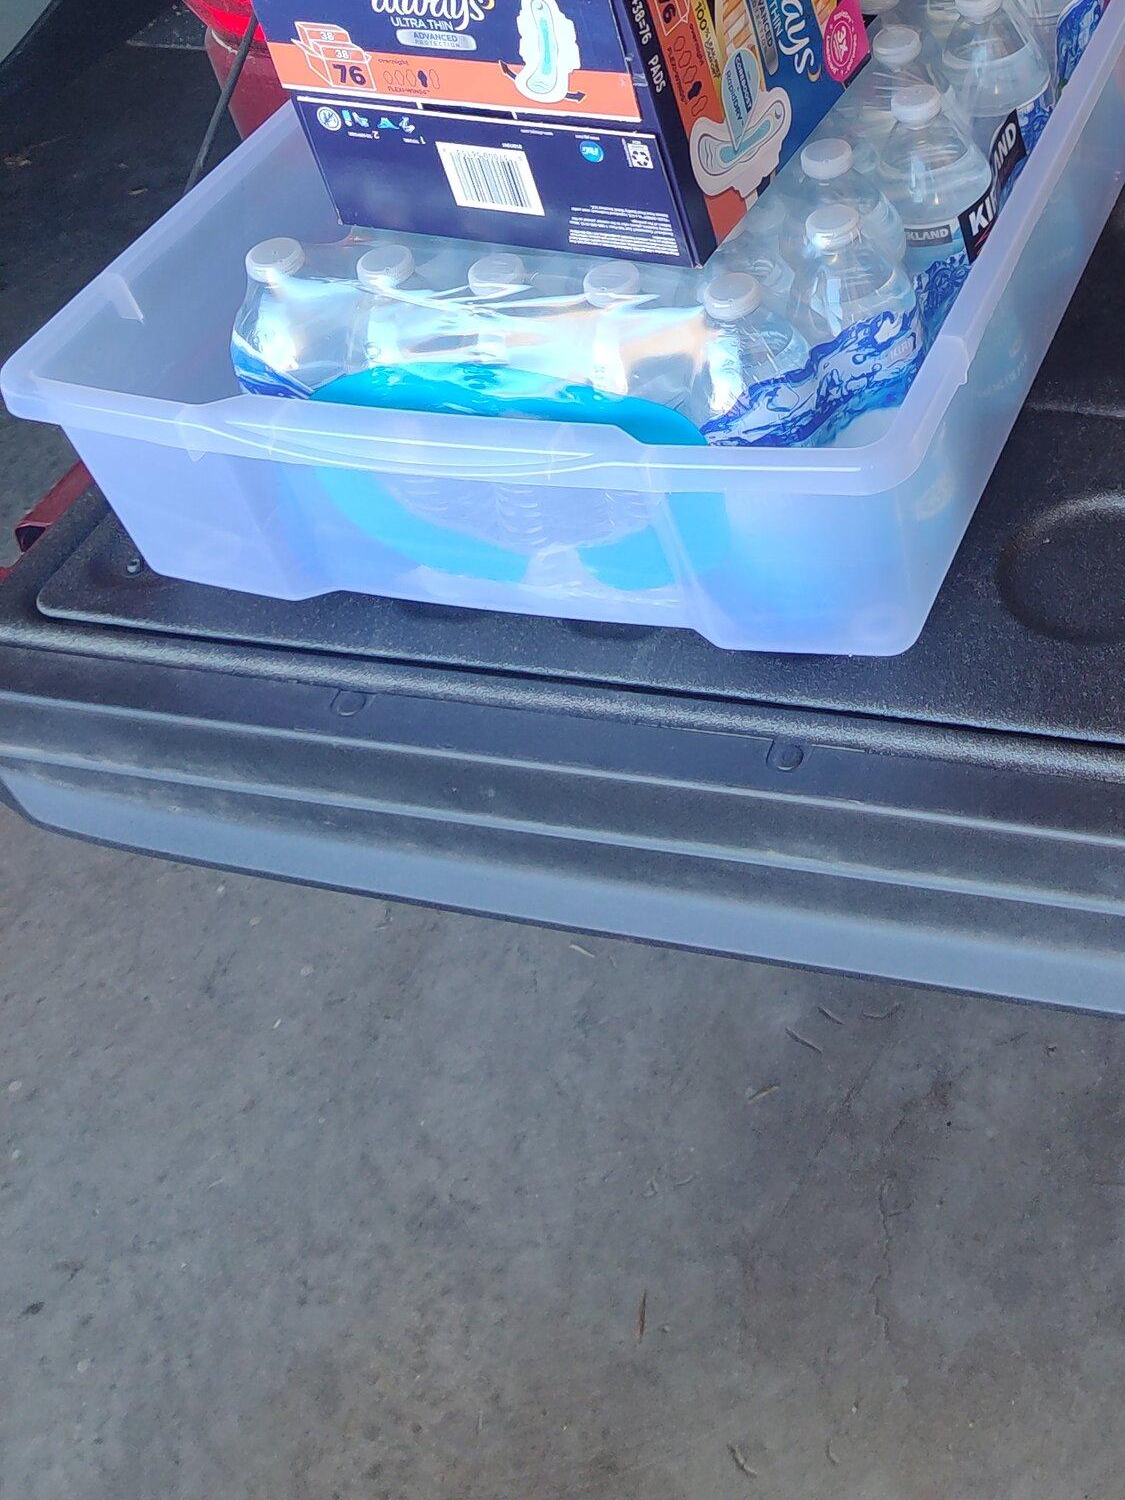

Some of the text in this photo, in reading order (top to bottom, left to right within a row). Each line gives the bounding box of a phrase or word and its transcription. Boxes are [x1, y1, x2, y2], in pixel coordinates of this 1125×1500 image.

[390, 16, 455, 32] ULTRA THIN
[320, 31, 335, 41] 38
[413, 30, 459, 43] ADVANCED
[335, 49, 350, 59] 38
[333, 64, 367, 86] 76
[647, 54, 667, 94] PADS
